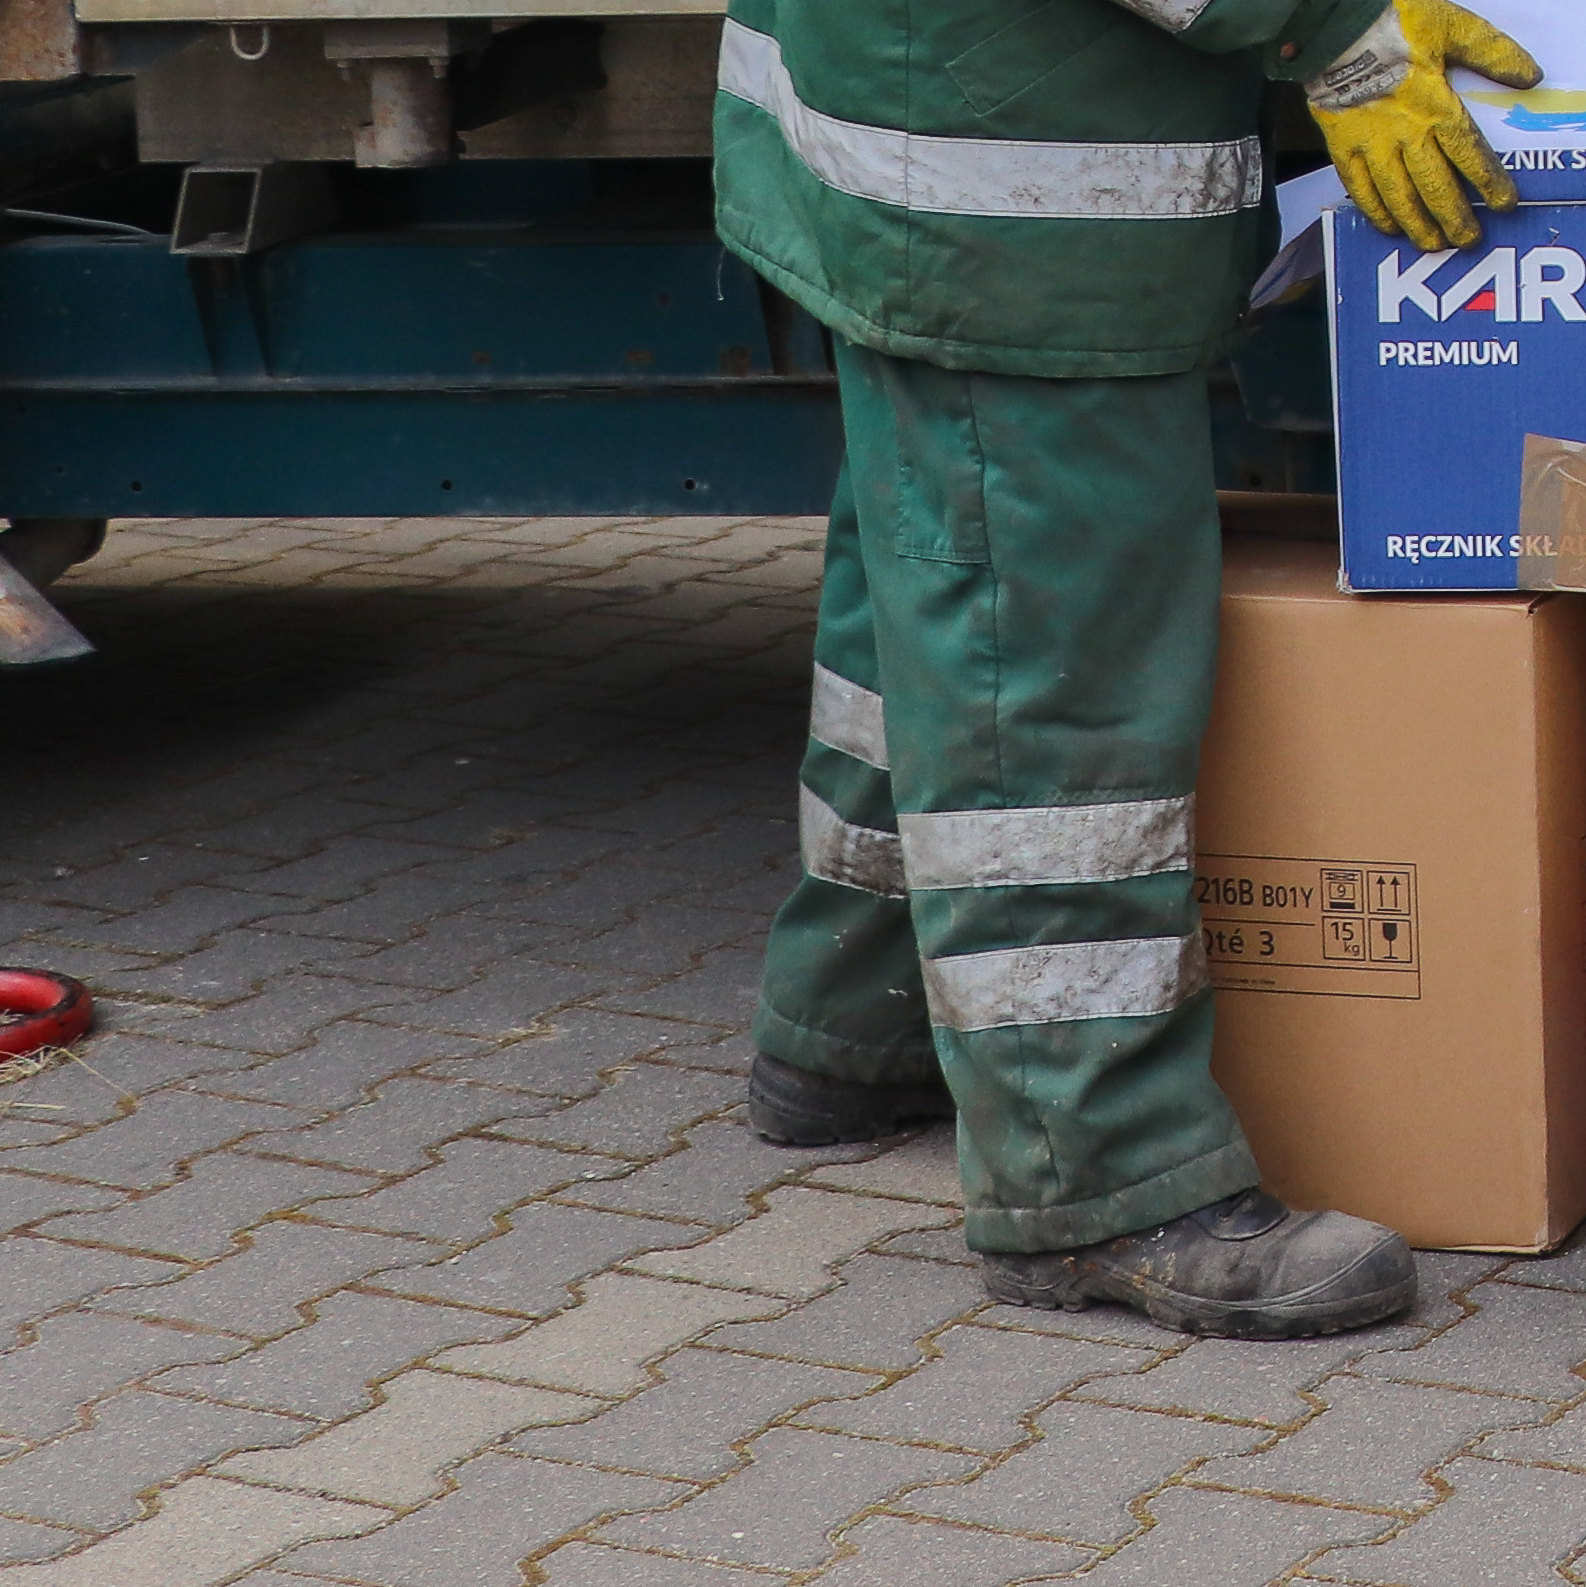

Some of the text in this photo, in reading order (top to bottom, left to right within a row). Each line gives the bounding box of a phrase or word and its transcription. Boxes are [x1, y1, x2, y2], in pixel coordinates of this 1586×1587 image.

[1378, 340, 1519, 366] PREMIUM
[1387, 535, 1503, 564] RĘCZNIK
[1262, 885, 1314, 909] B01Y
[1337, 885, 1346, 897] 9
[1330, 921, 1354, 941] 15
[1260, 931, 1275, 956] 3
[1343, 941, 1360, 956] kg
